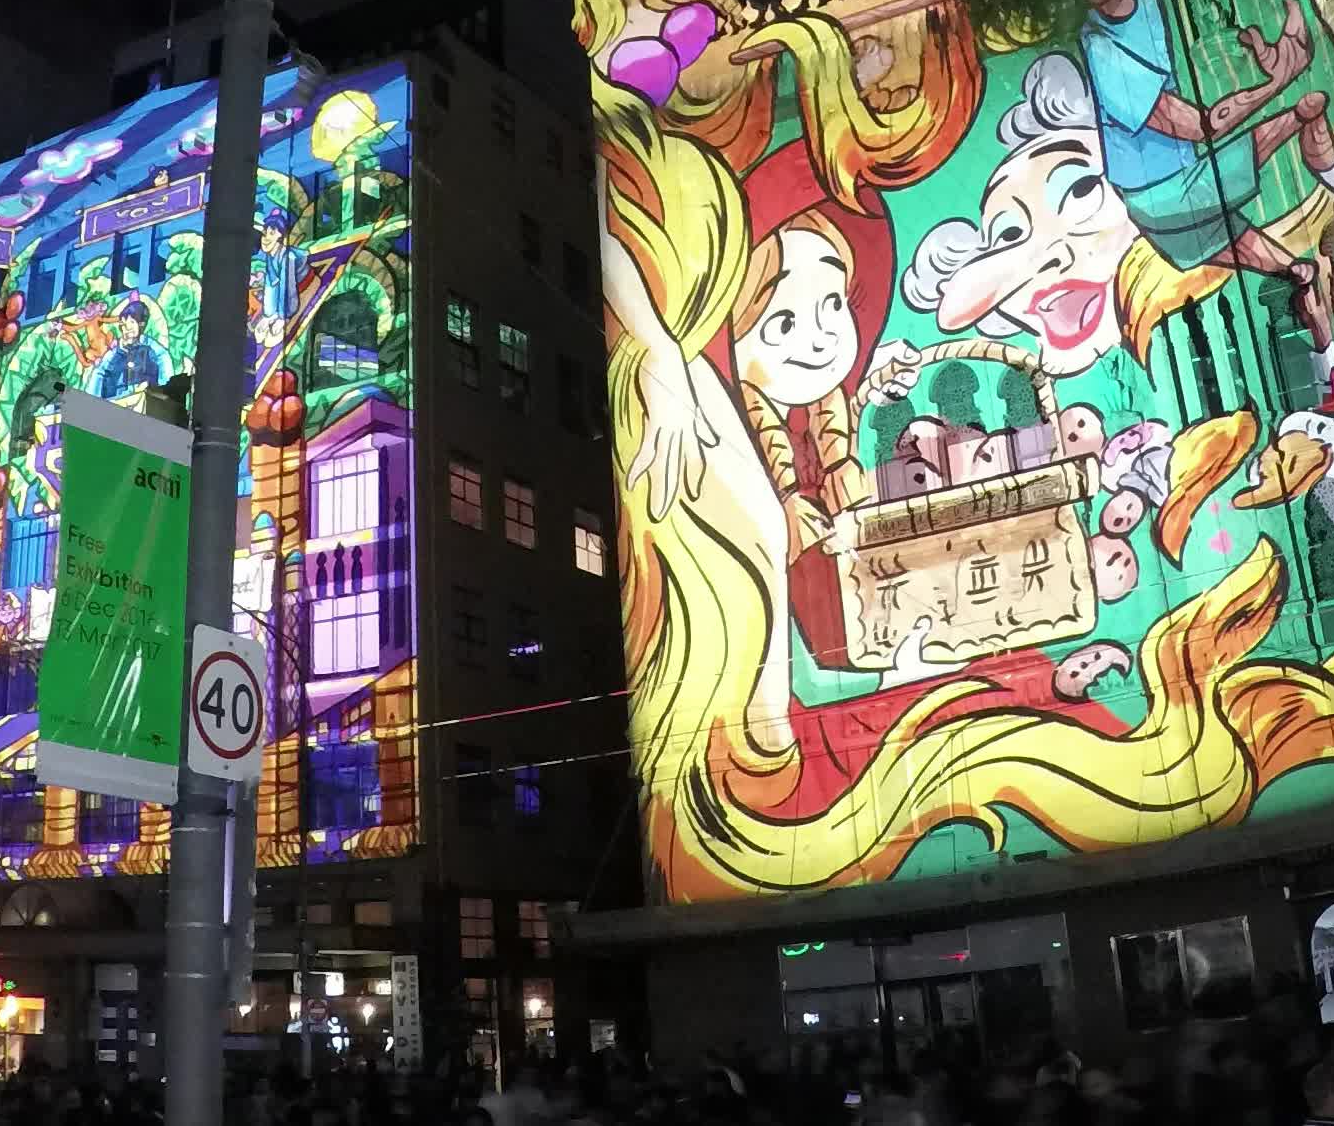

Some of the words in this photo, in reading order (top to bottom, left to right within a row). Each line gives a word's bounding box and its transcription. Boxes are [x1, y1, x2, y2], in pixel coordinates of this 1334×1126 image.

[134, 466, 181, 499] acmi
[68, 524, 106, 554] Free
[66, 554, 153, 601] Exhibition
[74, 591, 116, 618] Dec
[199, 676, 255, 735] 40
